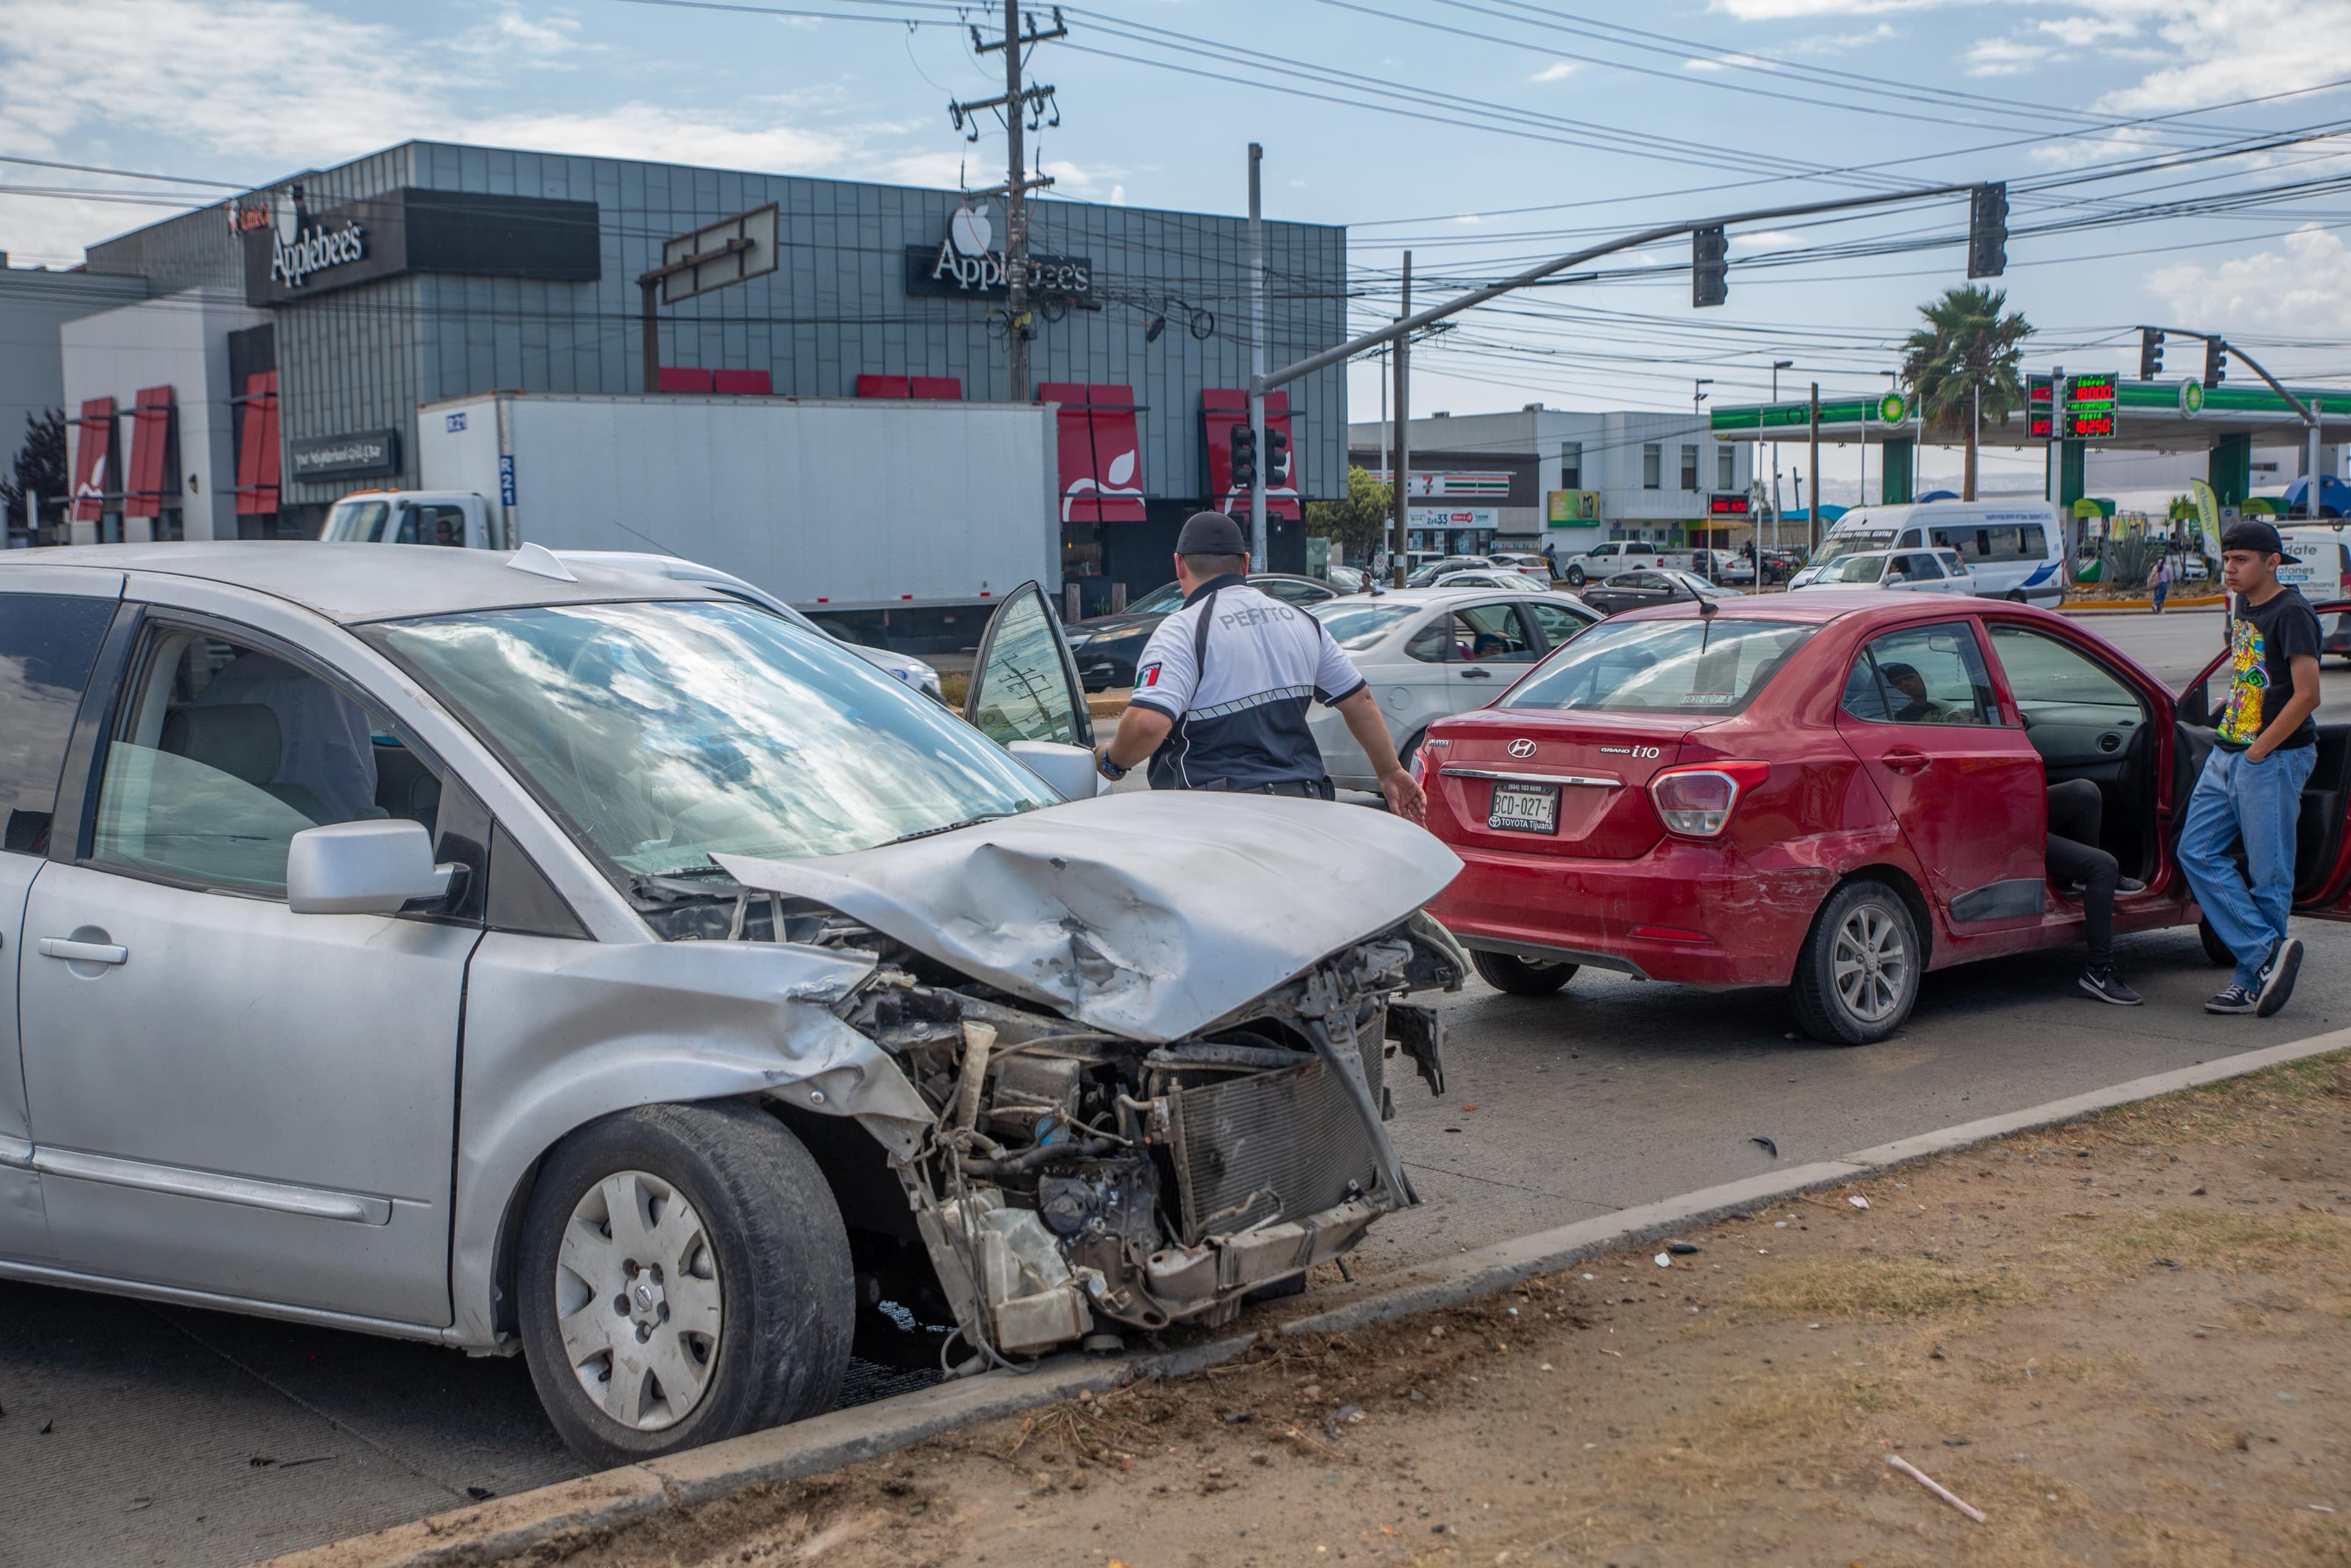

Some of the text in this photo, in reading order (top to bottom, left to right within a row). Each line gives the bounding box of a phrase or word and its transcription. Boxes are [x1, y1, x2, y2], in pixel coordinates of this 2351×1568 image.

[270, 218, 362, 288] Applebee's
[2076, 419, 2110, 433] 18250
[501, 458, 513, 505] R21
[1219, 607, 1294, 630] PERITO
[1501, 818, 1553, 830] TOYOTA Tijuana
